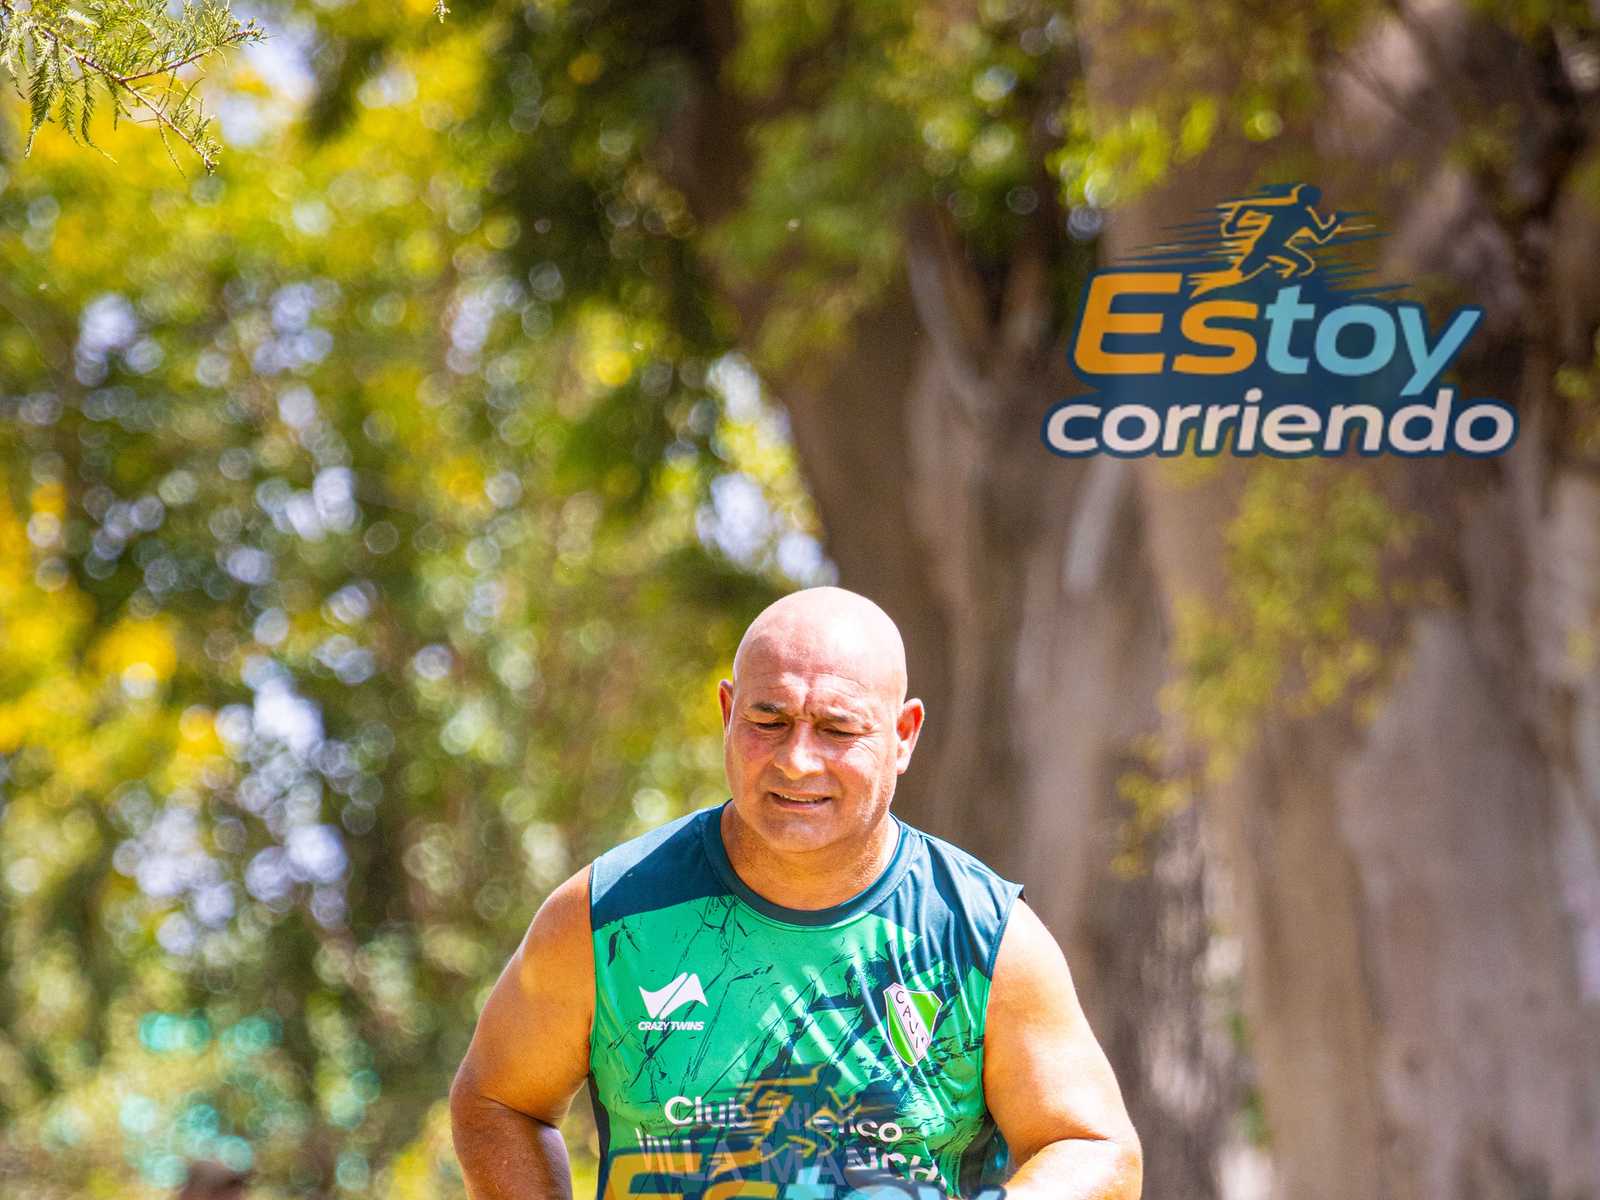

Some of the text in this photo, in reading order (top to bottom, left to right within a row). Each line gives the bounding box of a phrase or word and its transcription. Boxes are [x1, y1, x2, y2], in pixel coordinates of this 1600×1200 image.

[638, 1021, 705, 1031] CRAZY TWINS
[664, 1095, 750, 1129] Club
